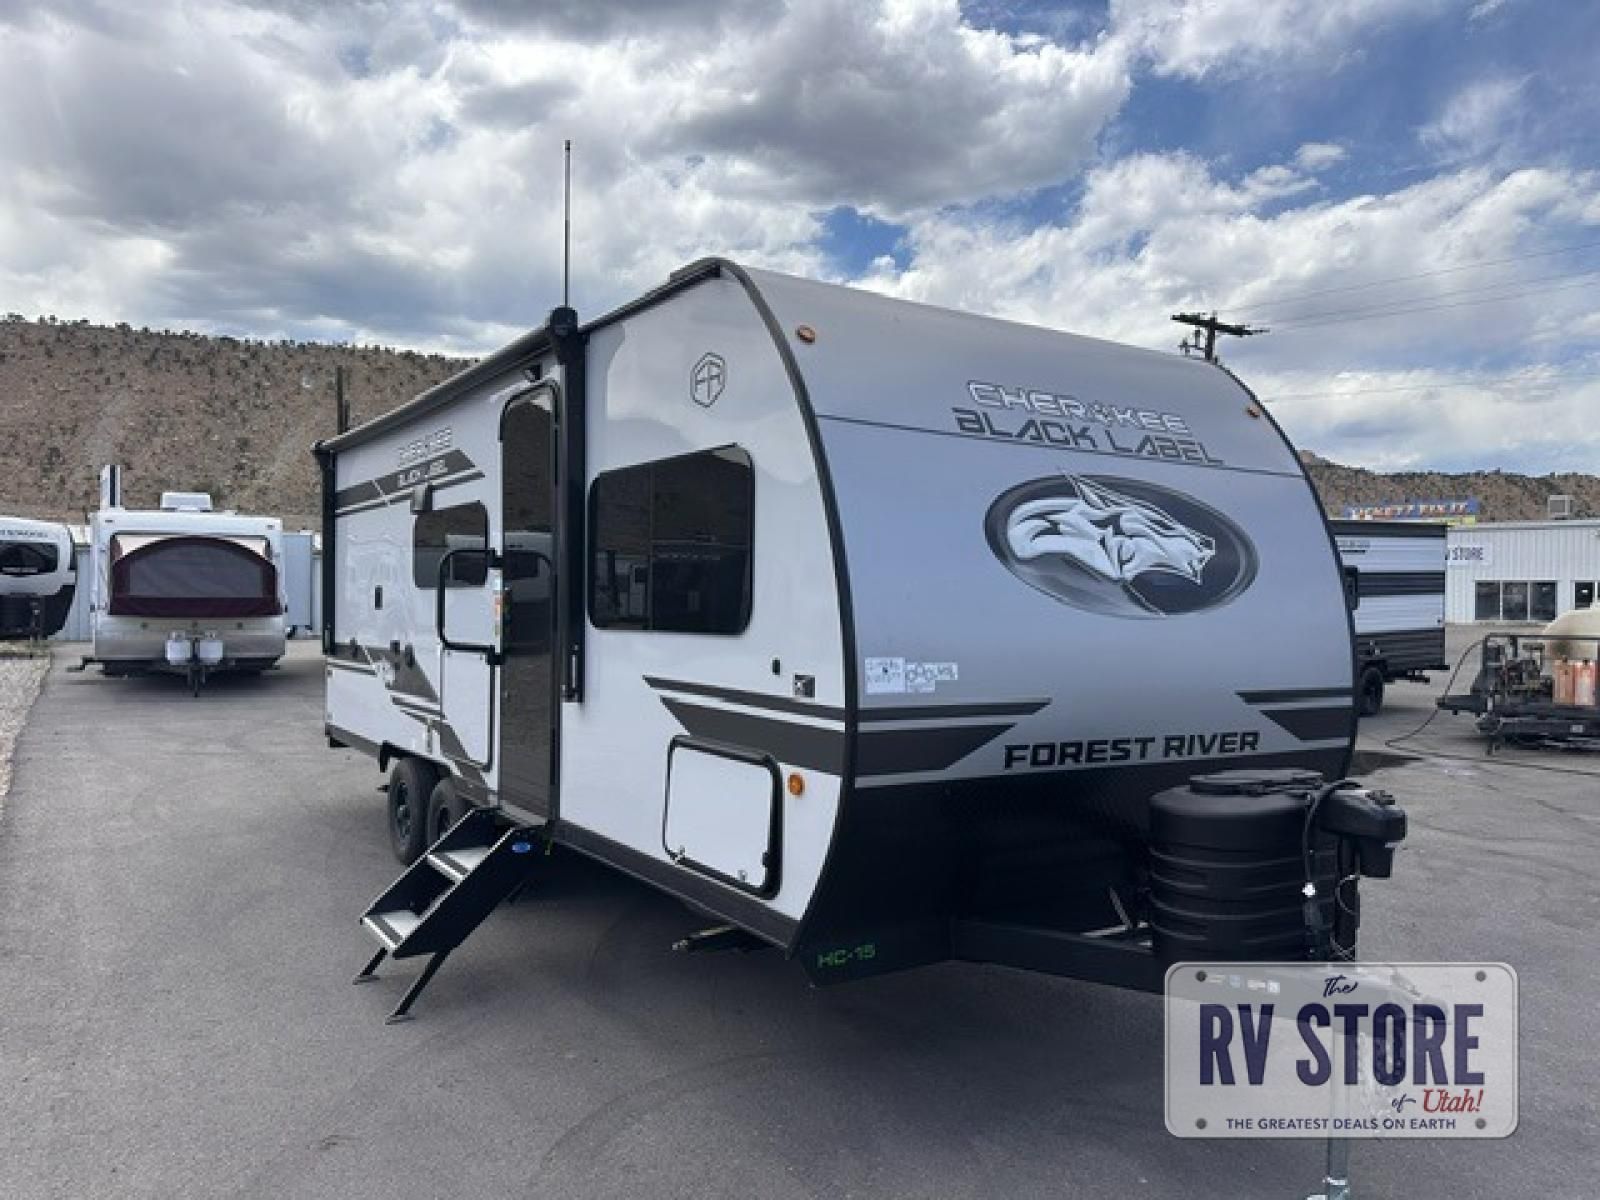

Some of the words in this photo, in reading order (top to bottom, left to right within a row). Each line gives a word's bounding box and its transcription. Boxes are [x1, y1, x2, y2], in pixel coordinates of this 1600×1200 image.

[952, 407, 1098, 450] BLACK
[1105, 430, 1224, 466] LABEL
[1004, 737, 1156, 769] FOREST
[1164, 732, 1260, 758] RIVER
